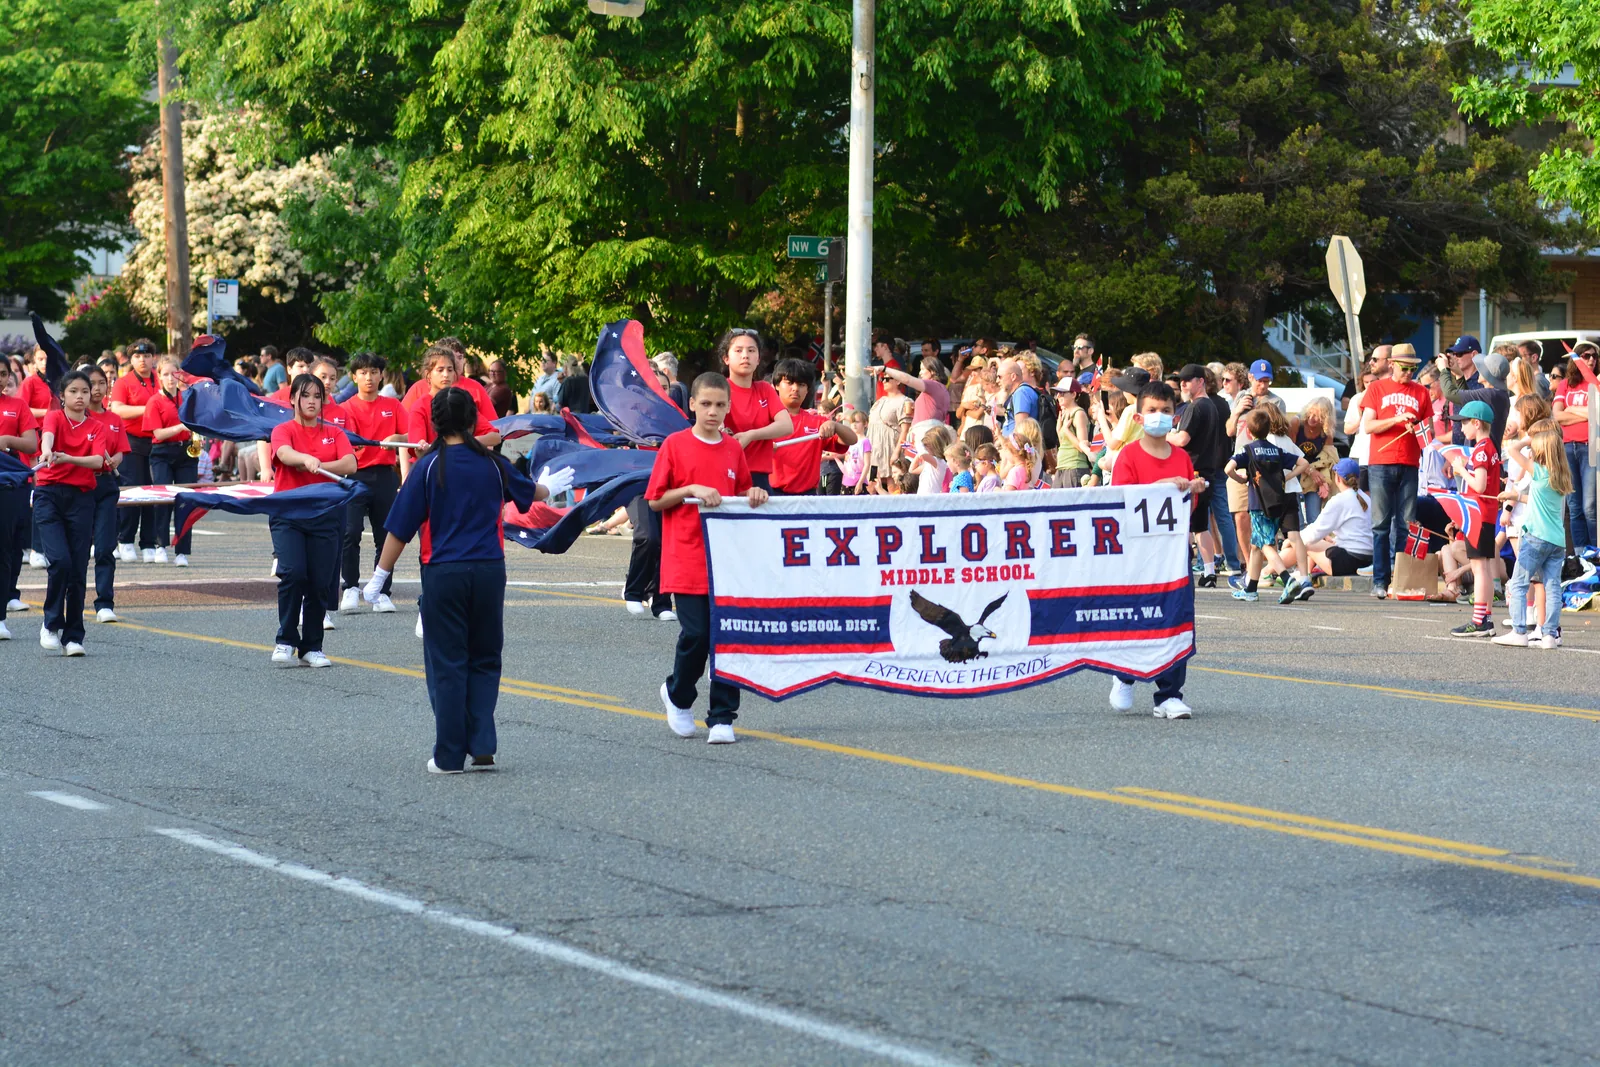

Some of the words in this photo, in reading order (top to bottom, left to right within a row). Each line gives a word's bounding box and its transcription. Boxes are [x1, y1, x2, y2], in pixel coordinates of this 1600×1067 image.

[791, 241, 809, 253] NW
[1134, 496, 1178, 533] 14
[780, 516, 1124, 567] EXPLORER
[880, 568, 955, 586] MIDDLE
[961, 564, 1035, 583] SCHOOL
[1075, 606, 1138, 622] EVERETT,
[1141, 605, 1163, 619] WA
[720, 618, 788, 633] MUKILTEO
[791, 618, 842, 633] SCHOOL
[845, 618, 880, 632] DIST.
[864, 659, 968, 684] EXPERIENCE
[971, 665, 1002, 683] THE
[1005, 653, 1053, 679] PRIDE
